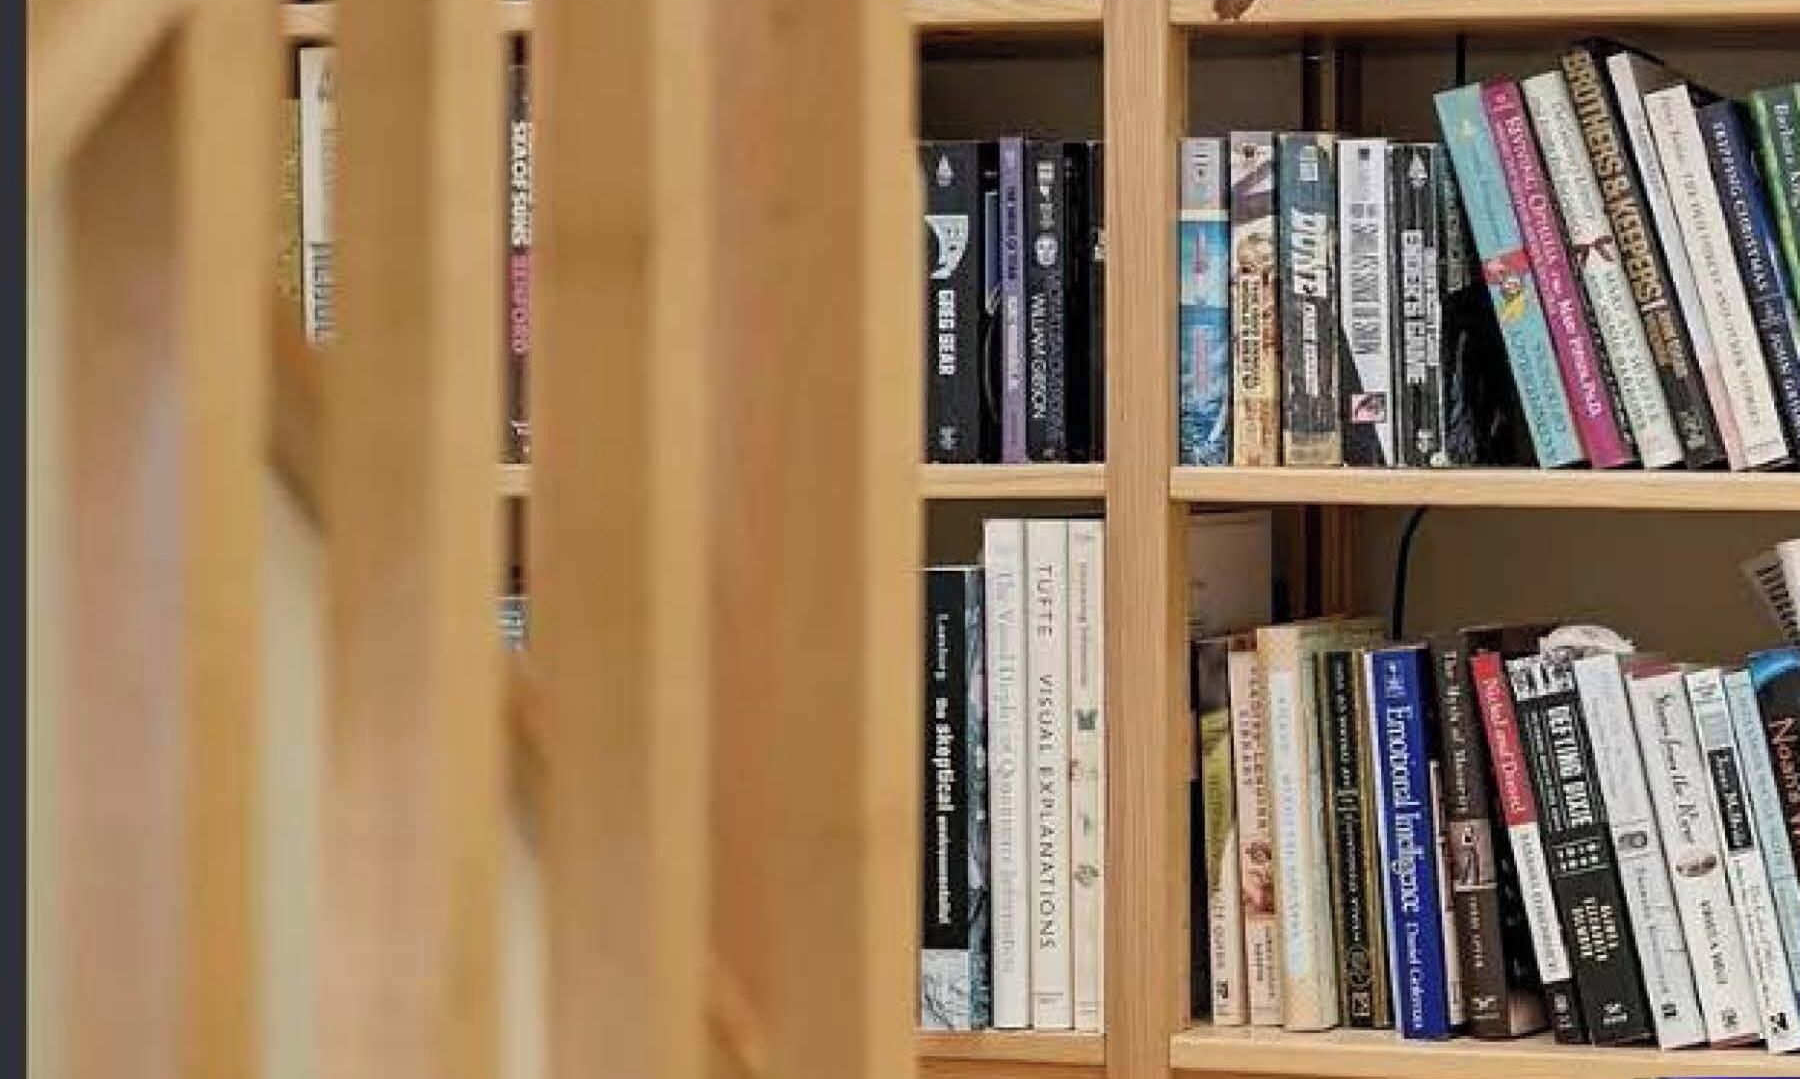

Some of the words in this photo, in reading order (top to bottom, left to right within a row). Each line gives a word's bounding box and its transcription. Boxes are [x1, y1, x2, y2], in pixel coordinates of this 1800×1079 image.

[1563, 52, 1623, 174] BROTHERS
[1036, 564, 1053, 637] TUFTE
[1037, 674, 1055, 752] VISUAL
[1493, 727, 1515, 758] and
[1548, 704, 1584, 779] DEFYING
[931, 723, 955, 812] skeptical
[1384, 705, 1420, 808] Emotional
[1565, 779, 1593, 828] DIXIE
[1037, 766, 1057, 950] EXPLANATIONS
[1391, 812, 1426, 913] Intelligence
